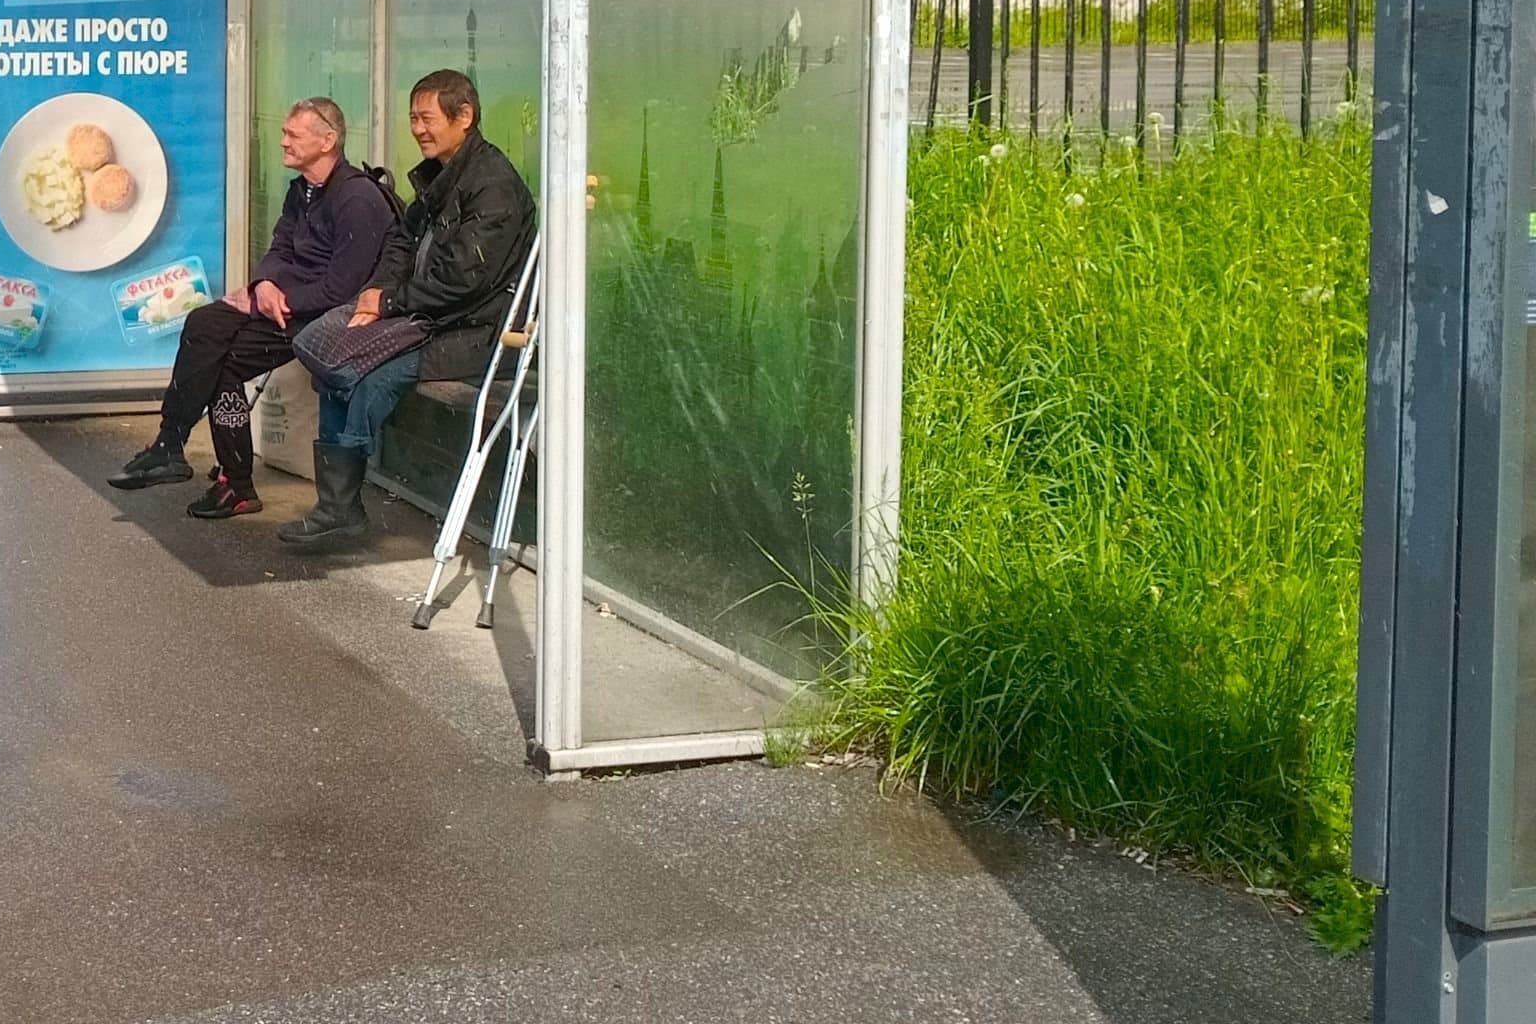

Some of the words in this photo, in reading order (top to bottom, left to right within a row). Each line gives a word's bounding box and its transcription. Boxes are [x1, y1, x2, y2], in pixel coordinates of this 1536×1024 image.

[74, 17, 168, 42] ПРОСТО
[96, 51, 111, 75] С
[117, 50, 188, 75] ПЮРЕ
[214, 413, 249, 428] Kapp
